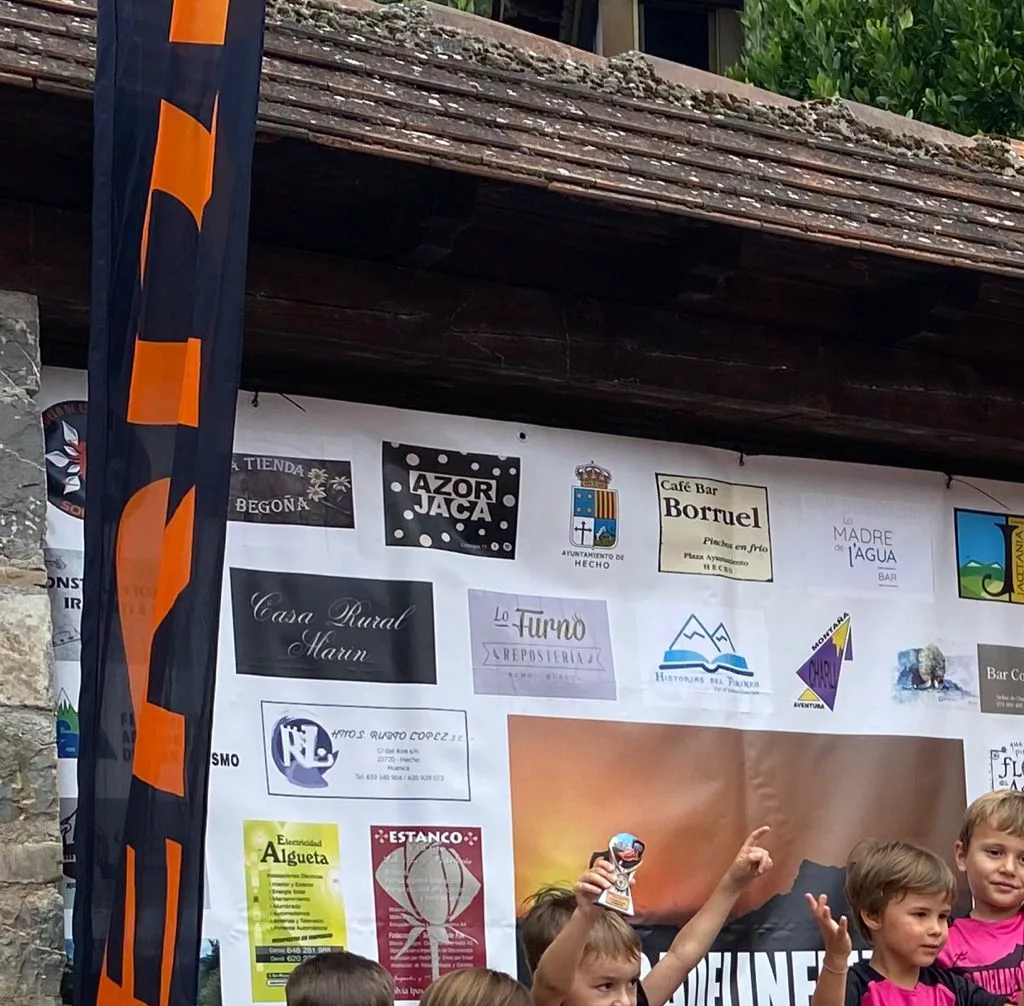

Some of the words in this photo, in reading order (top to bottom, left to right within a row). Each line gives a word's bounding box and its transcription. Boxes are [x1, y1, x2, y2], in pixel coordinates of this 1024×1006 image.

[243, 456, 305, 477] TIENDA
[412, 473, 494, 501] AZOR
[661, 479, 692, 493] Café
[695, 484, 718, 497] Bar
[236, 495, 311, 514] BEGOÑA
[414, 495, 492, 523] JACA
[663, 496, 763, 529] Borruel
[833, 525, 894, 547] MADRE
[561, 550, 614, 560] AYUNTAMIENTO
[734, 543, 748, 551] en
[834, 543, 845, 552] de
[683, 552, 704, 560] Plaza
[574, 560, 610, 570] HECHO
[878, 571, 898, 582] BAR
[250, 591, 314, 625] Casa
[326, 596, 417, 632] Rural
[493, 605, 509, 624] Lo
[811, 611, 851, 652] MONTAÑA
[986, 665, 1009, 680] Bar
[793, 701, 826, 710] AVENTURA
[211, 753, 240, 768] SMO
[277, 834, 323, 848] Electricidad
[388, 831, 463, 845] ESTANCO
[261, 841, 329, 867] Algueta
